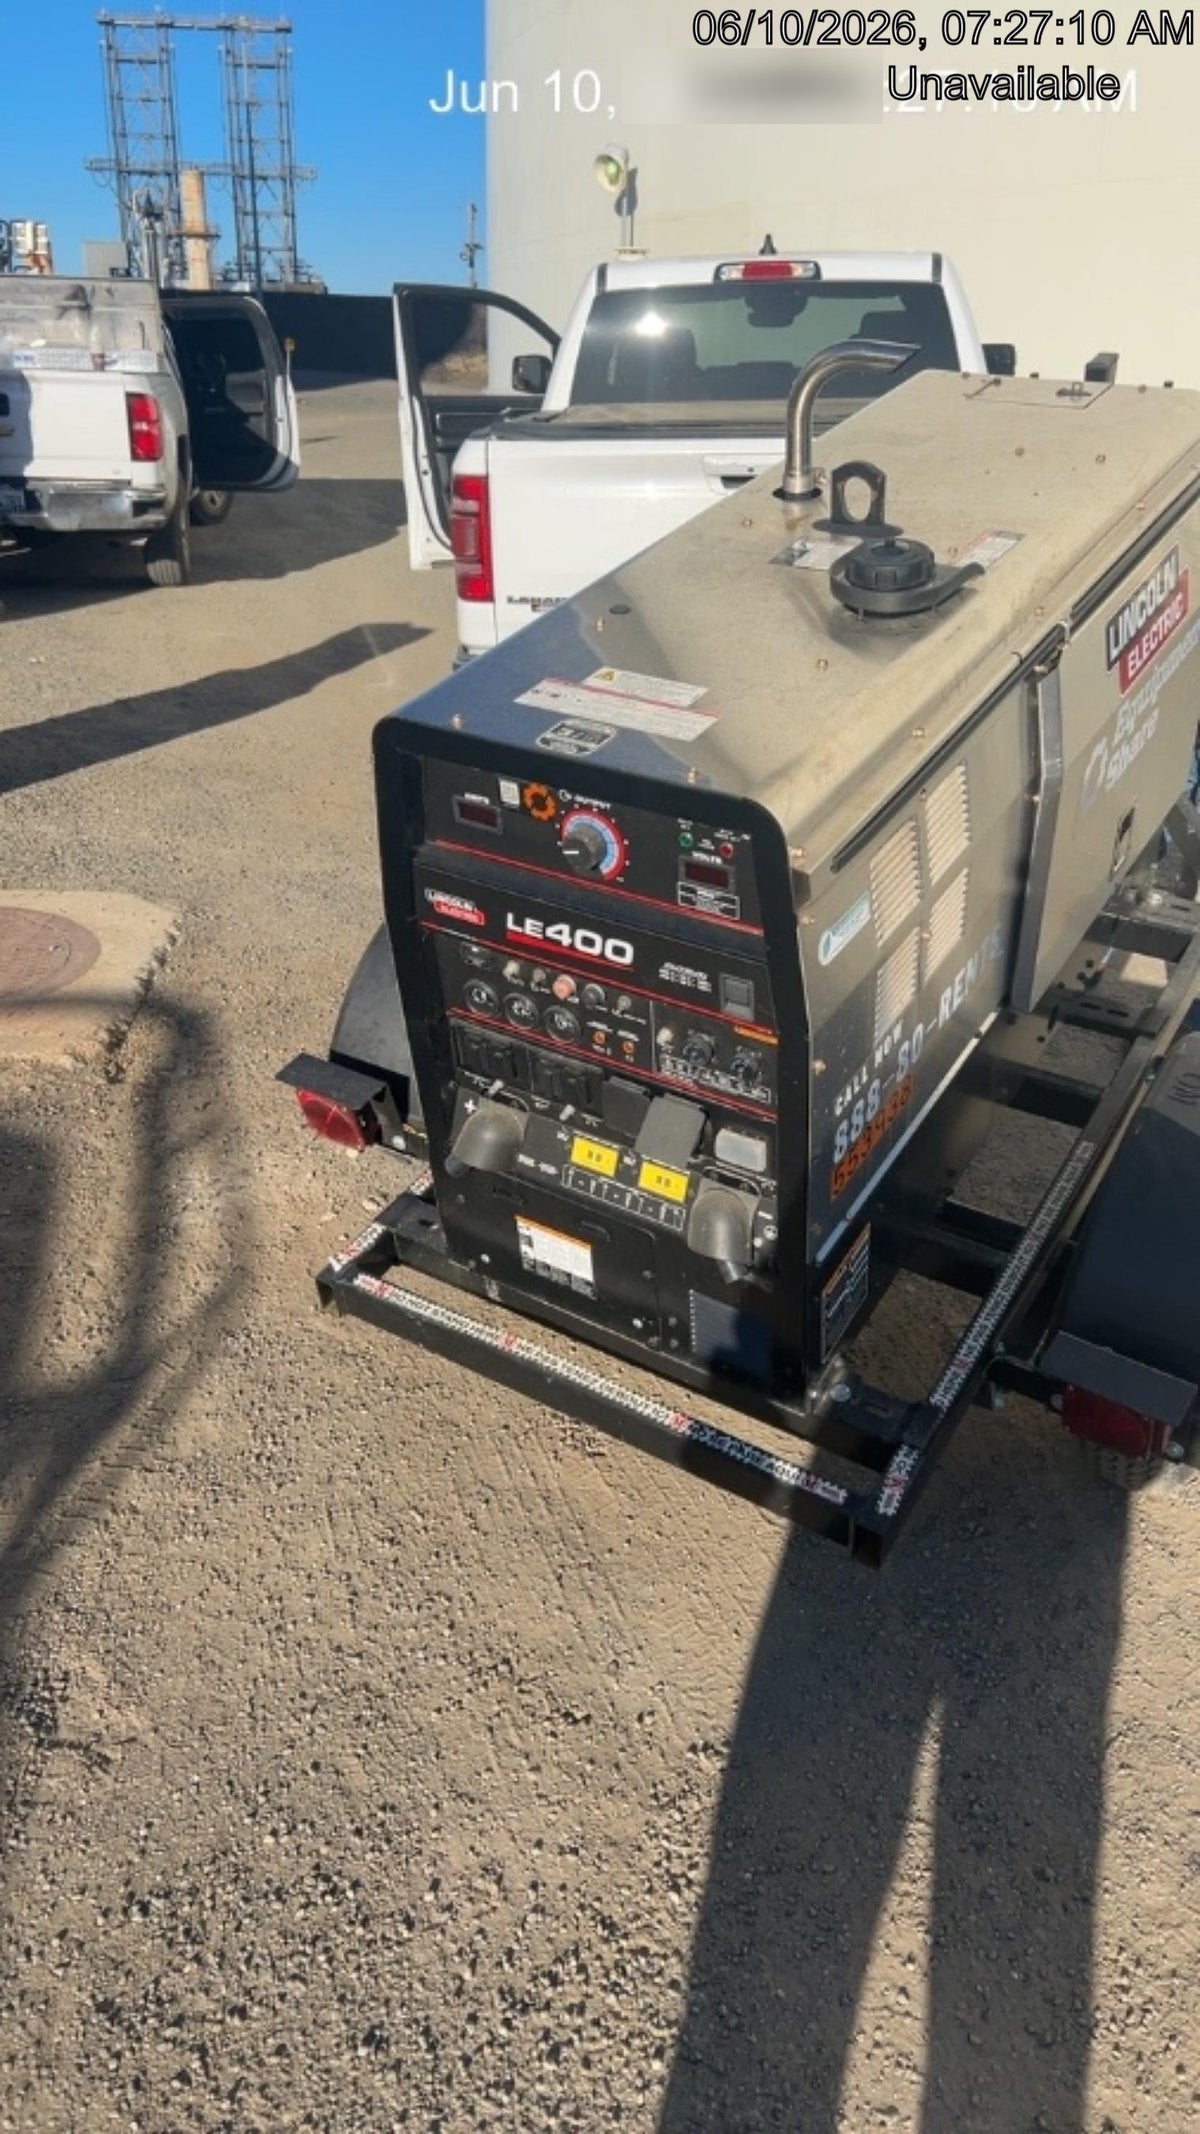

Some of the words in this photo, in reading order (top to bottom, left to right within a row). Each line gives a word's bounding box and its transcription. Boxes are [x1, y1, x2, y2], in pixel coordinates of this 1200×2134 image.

[1109, 552, 1178, 663] LINCOLN
[1127, 592, 1184, 679] ELECTRIC
[506, 911, 635, 966] LE400
[833, 1065, 869, 1118] CALL
[874, 1019, 904, 1069] NOW
